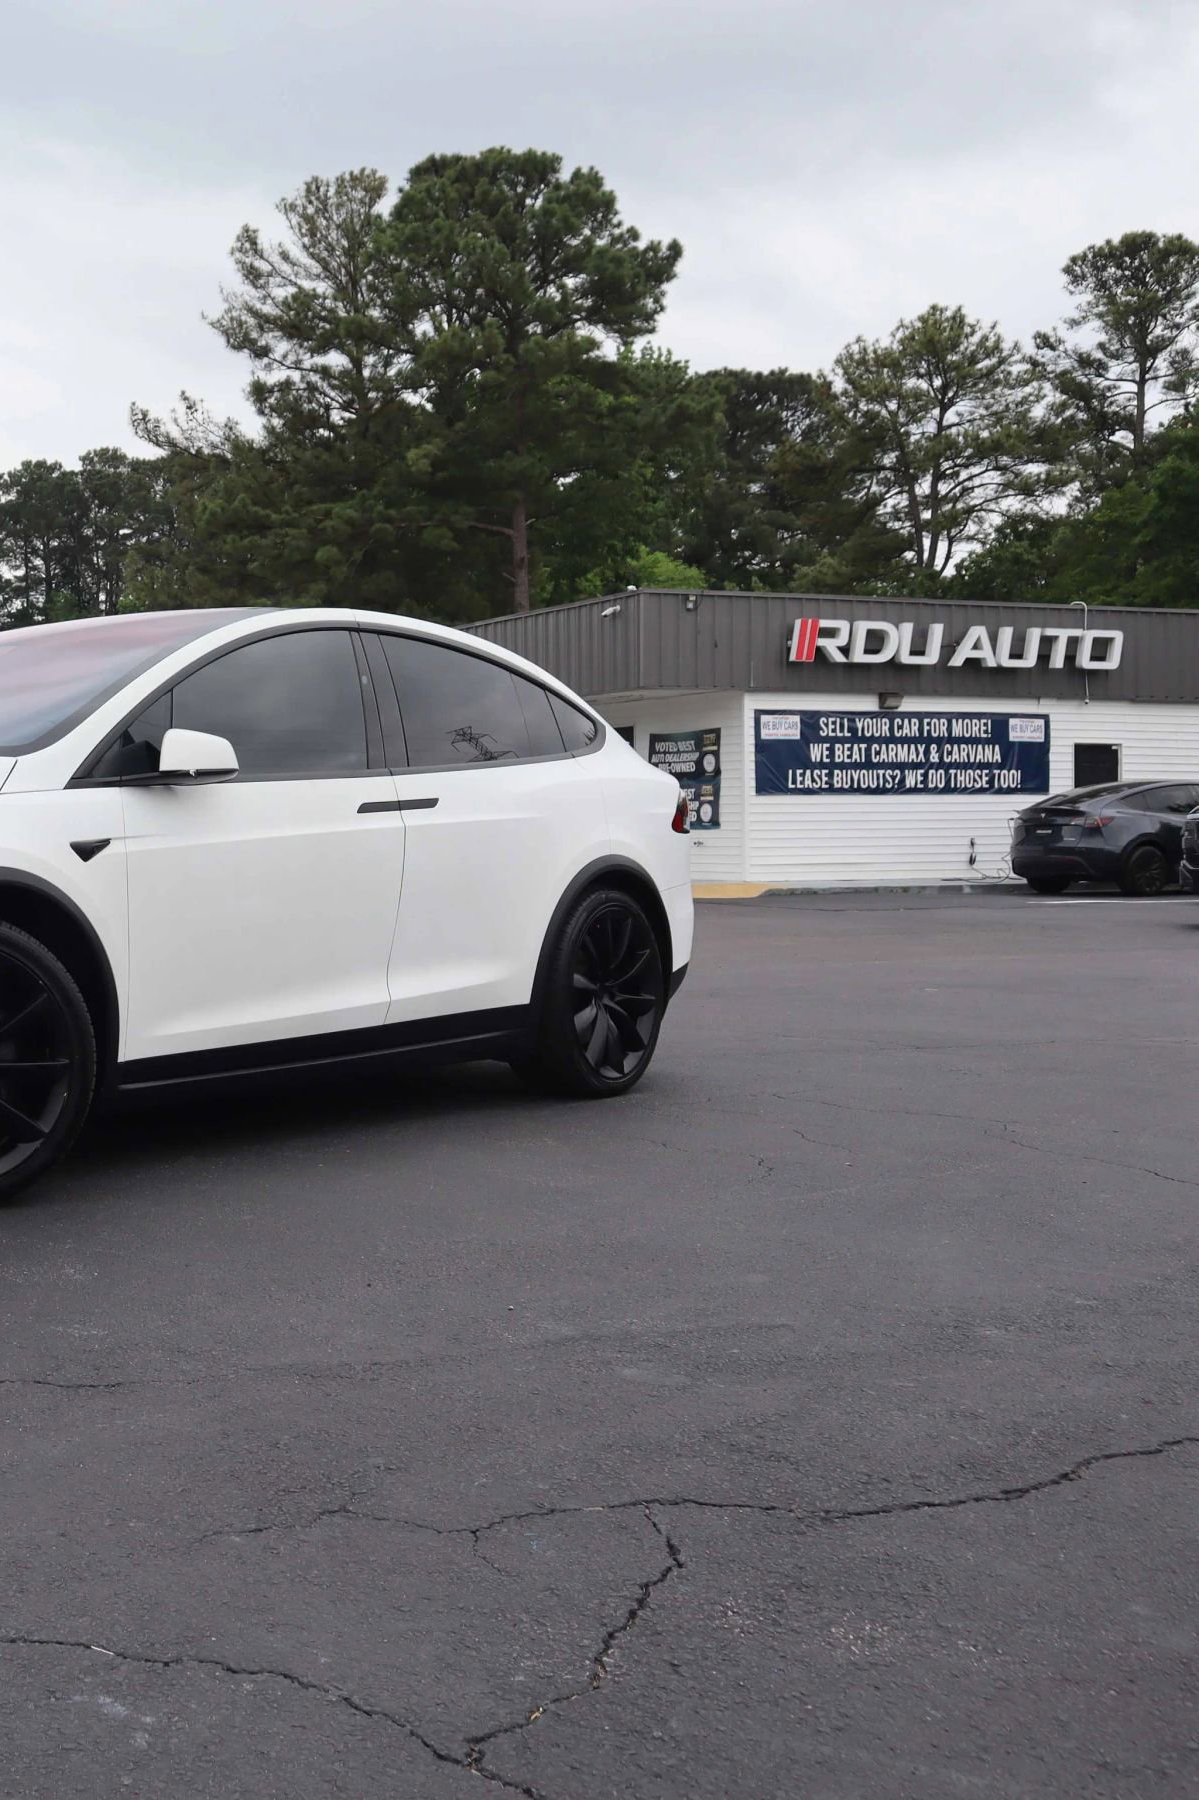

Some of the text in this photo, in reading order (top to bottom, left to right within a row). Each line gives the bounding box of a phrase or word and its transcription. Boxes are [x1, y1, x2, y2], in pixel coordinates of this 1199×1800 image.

[807, 618, 1123, 670] RDU AUTO
[819, 717, 992, 738] SELL YOUR CAR FOR MORE!
[655, 741, 678, 752] VOTED
[809, 743, 1002, 763] WE BEAT CARMAX & CARVANA
[788, 769, 1022, 789] LEASE BUYOUTS? WE DO THOSE TOO!
